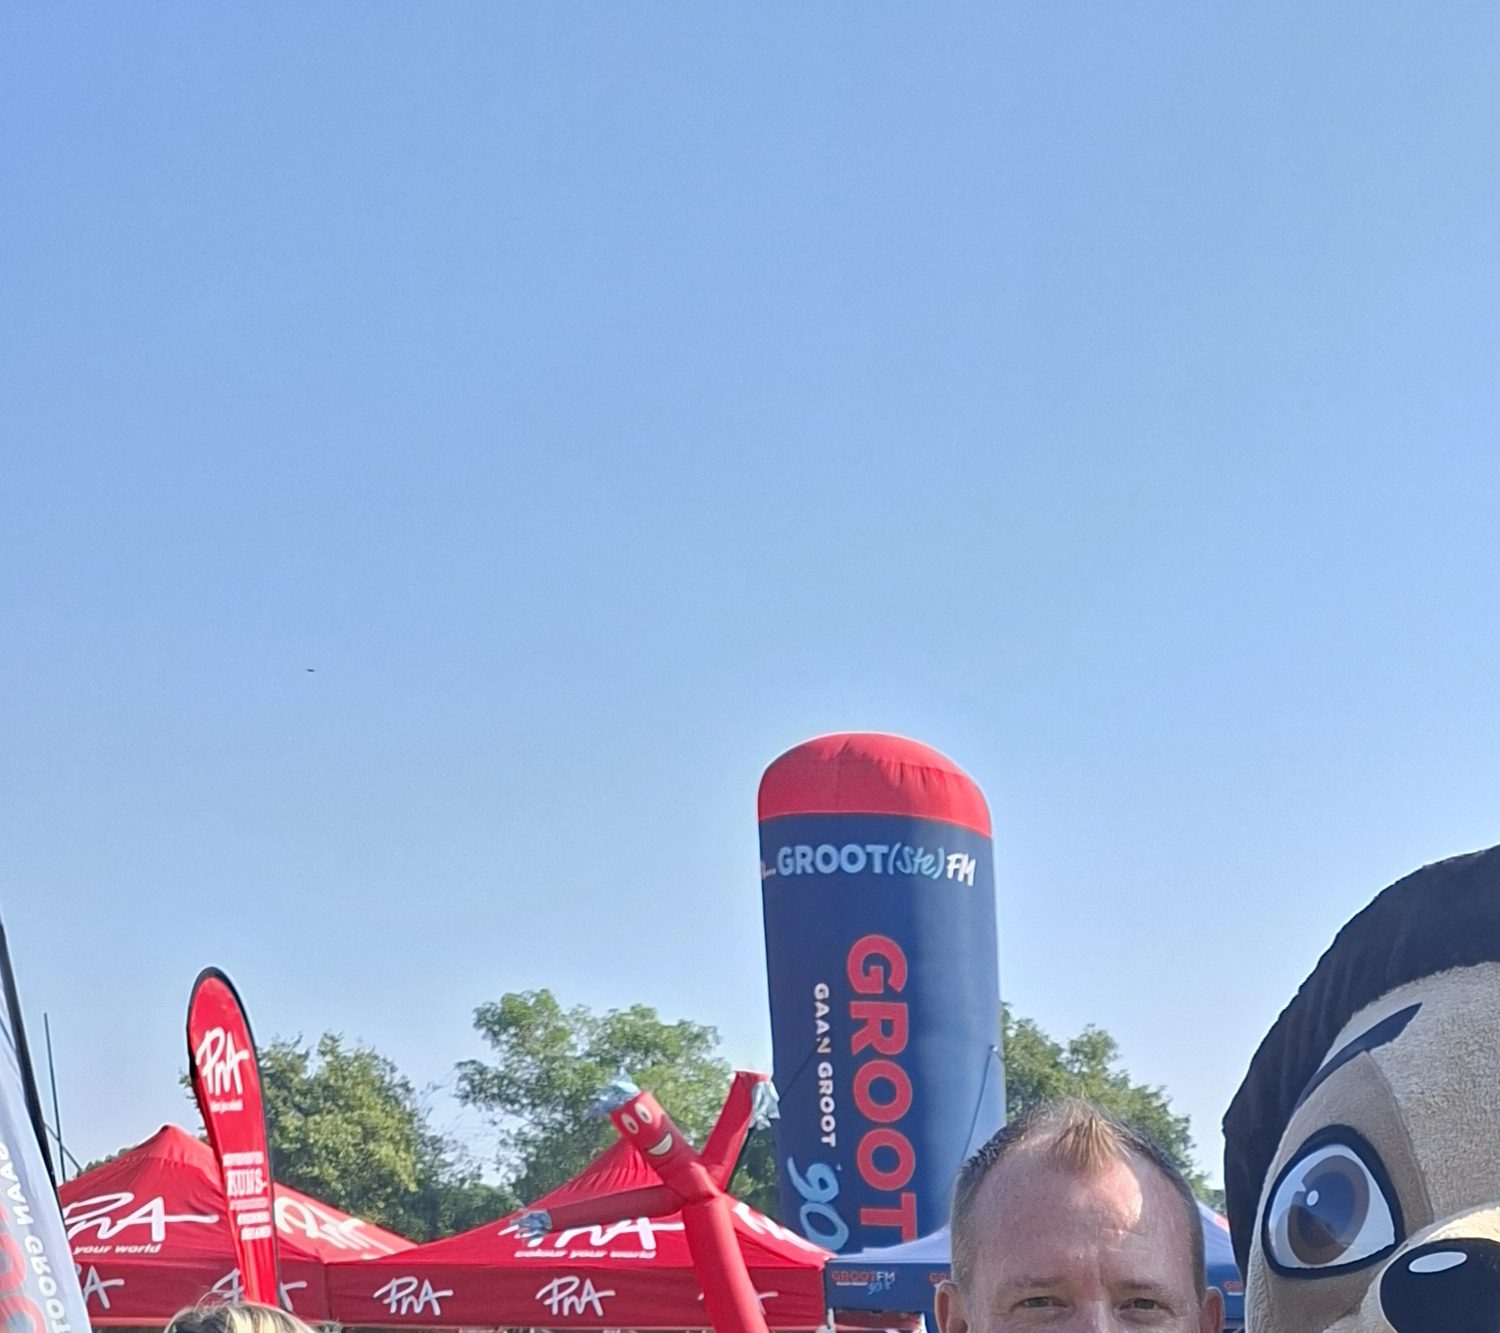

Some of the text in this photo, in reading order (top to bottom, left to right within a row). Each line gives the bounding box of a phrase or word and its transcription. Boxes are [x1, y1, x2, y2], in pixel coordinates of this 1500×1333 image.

[814, 983, 832, 1055] GAAN
[817, 1062, 837, 1148] GROOT
[73, 1243, 162, 1255] your world
[372, 1276, 454, 1317] PnA
[535, 1276, 616, 1317] PnA
